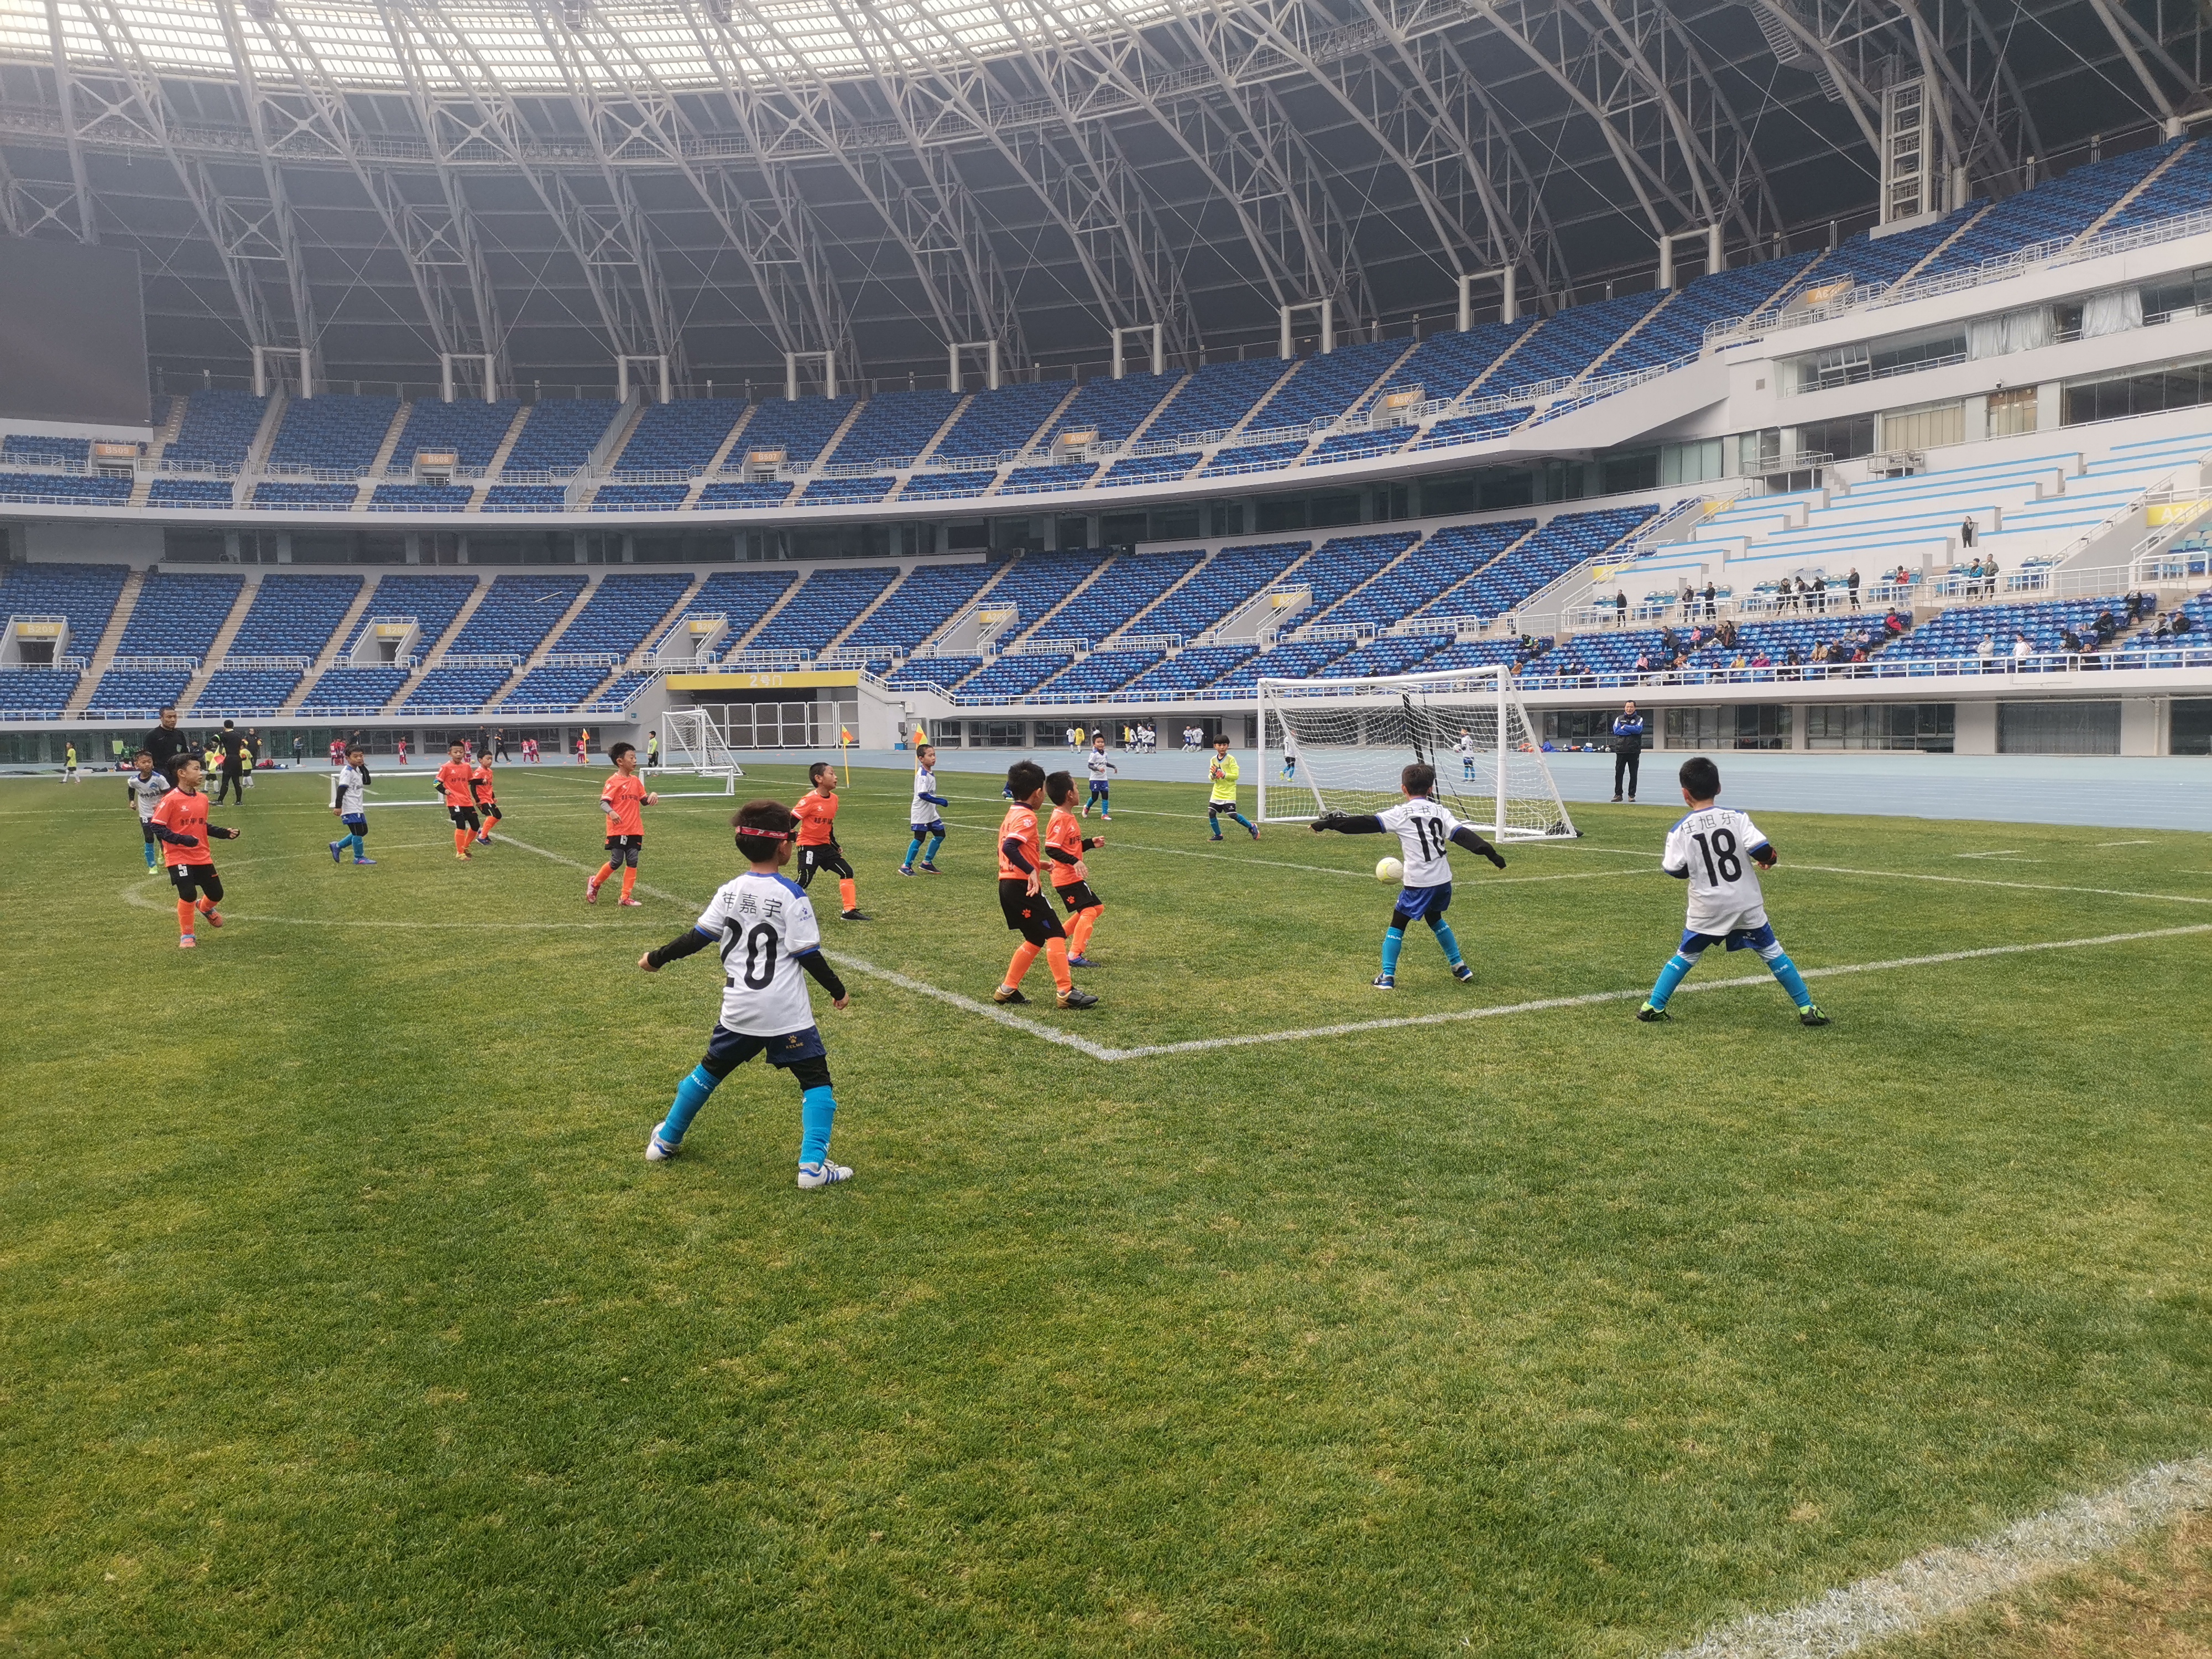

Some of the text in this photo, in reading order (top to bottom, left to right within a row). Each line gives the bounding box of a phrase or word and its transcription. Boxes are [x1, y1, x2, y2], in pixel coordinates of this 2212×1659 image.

[749, 674, 782, 687] 2号门
[806, 850, 813, 865] 8
[1692, 828, 1742, 887] 18
[178, 863, 189, 877] 5
